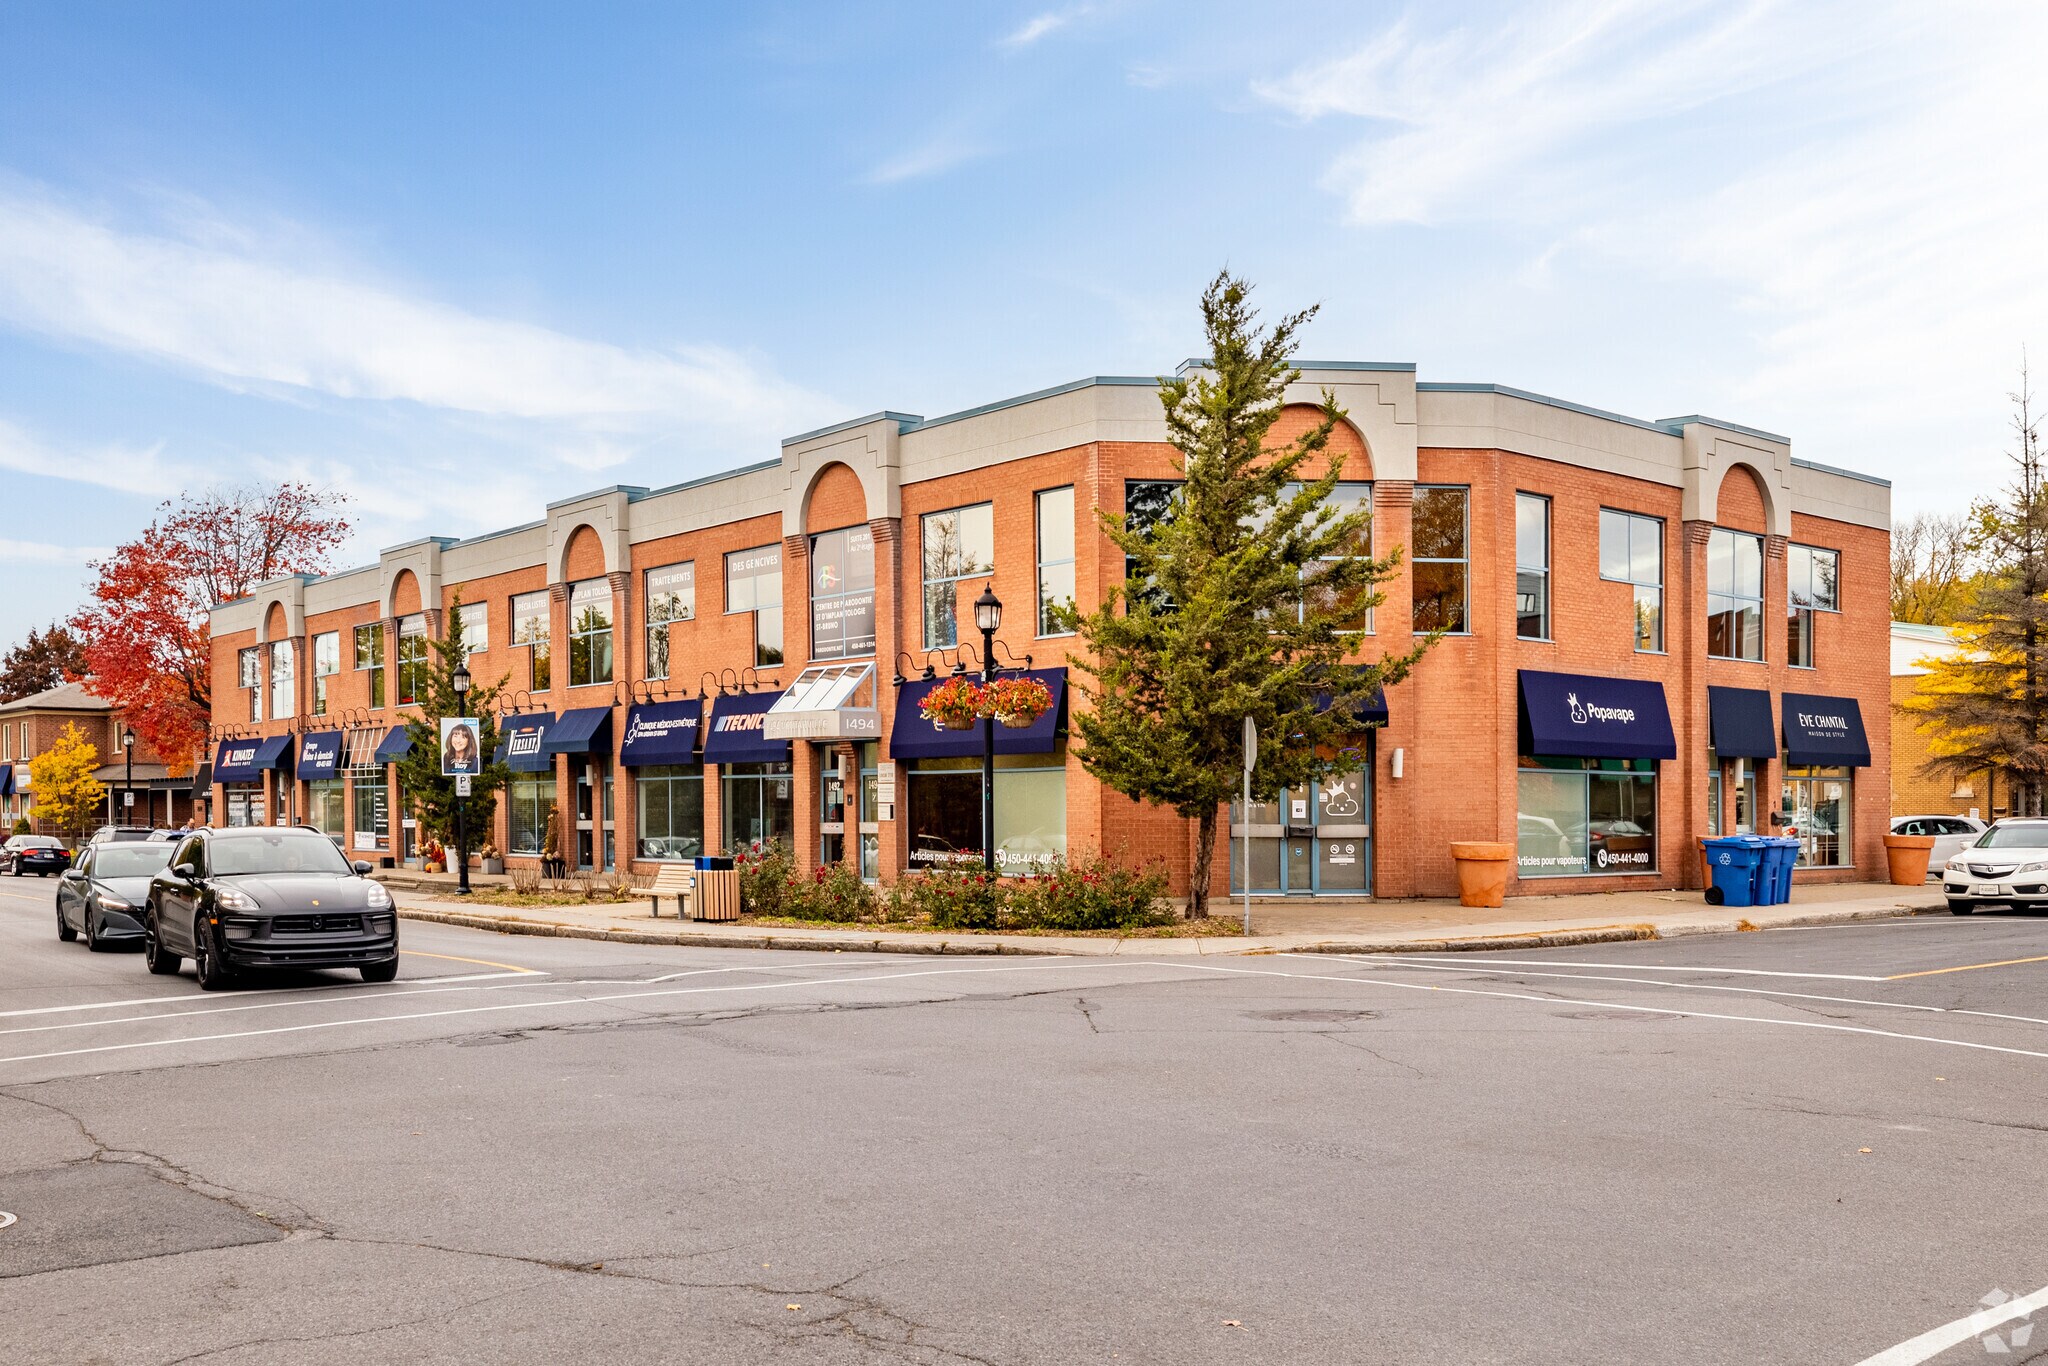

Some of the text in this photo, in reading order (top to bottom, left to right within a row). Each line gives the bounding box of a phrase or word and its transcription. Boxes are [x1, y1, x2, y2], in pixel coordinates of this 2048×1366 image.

[732, 555, 778, 572] DES GENCIVES
[651, 571, 691, 588] TRAITEMENTS
[833, 601, 840, 609] DE
[1586, 702, 1635, 724] Popavape
[724, 713, 767, 731] TECNIC
[846, 718, 875, 730] 1494
[1815, 715, 1849, 729] CHANTAL
[868, 779, 878, 790] 149
[910, 850, 934, 861] Articles
[1517, 852, 1649, 867] Articles pour vapoteurs 450-441-4000
